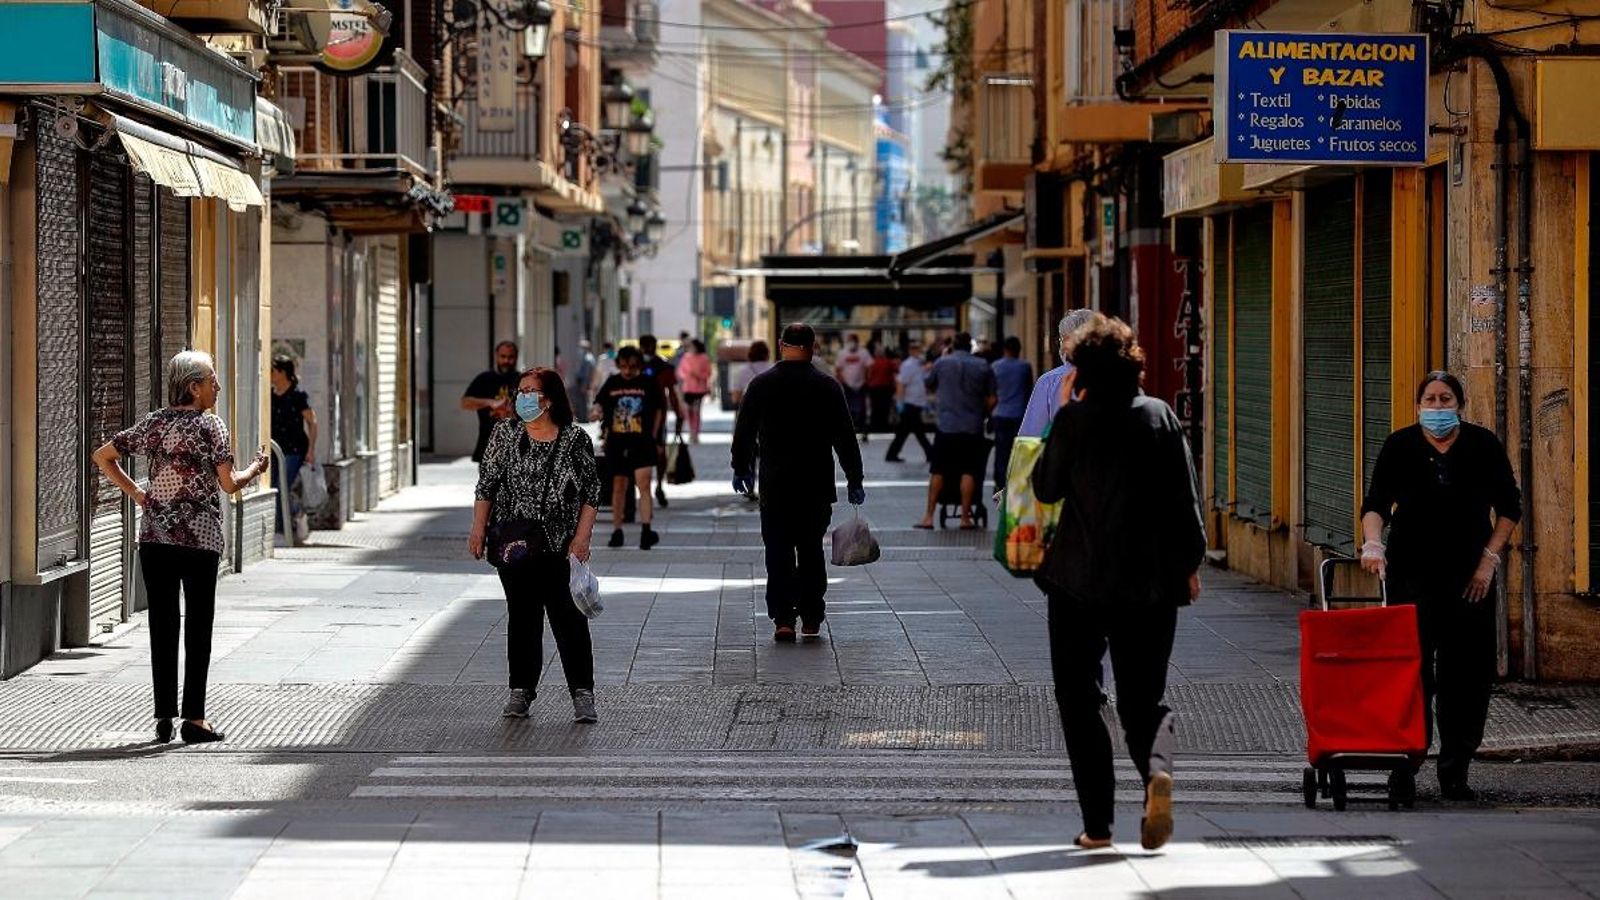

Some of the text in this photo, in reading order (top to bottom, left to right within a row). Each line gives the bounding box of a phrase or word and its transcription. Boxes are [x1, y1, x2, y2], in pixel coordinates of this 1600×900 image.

[330, 20, 368, 31] MSTEL
[1238, 41, 1416, 62] ALIMENTACION
[1269, 66, 1384, 87] Y BAZAR
[1250, 92, 1291, 108] Textil
[1250, 112, 1304, 130] Regalos
[1250, 134, 1311, 153] Juguetes
[1329, 136, 1417, 153] Frutos secos
